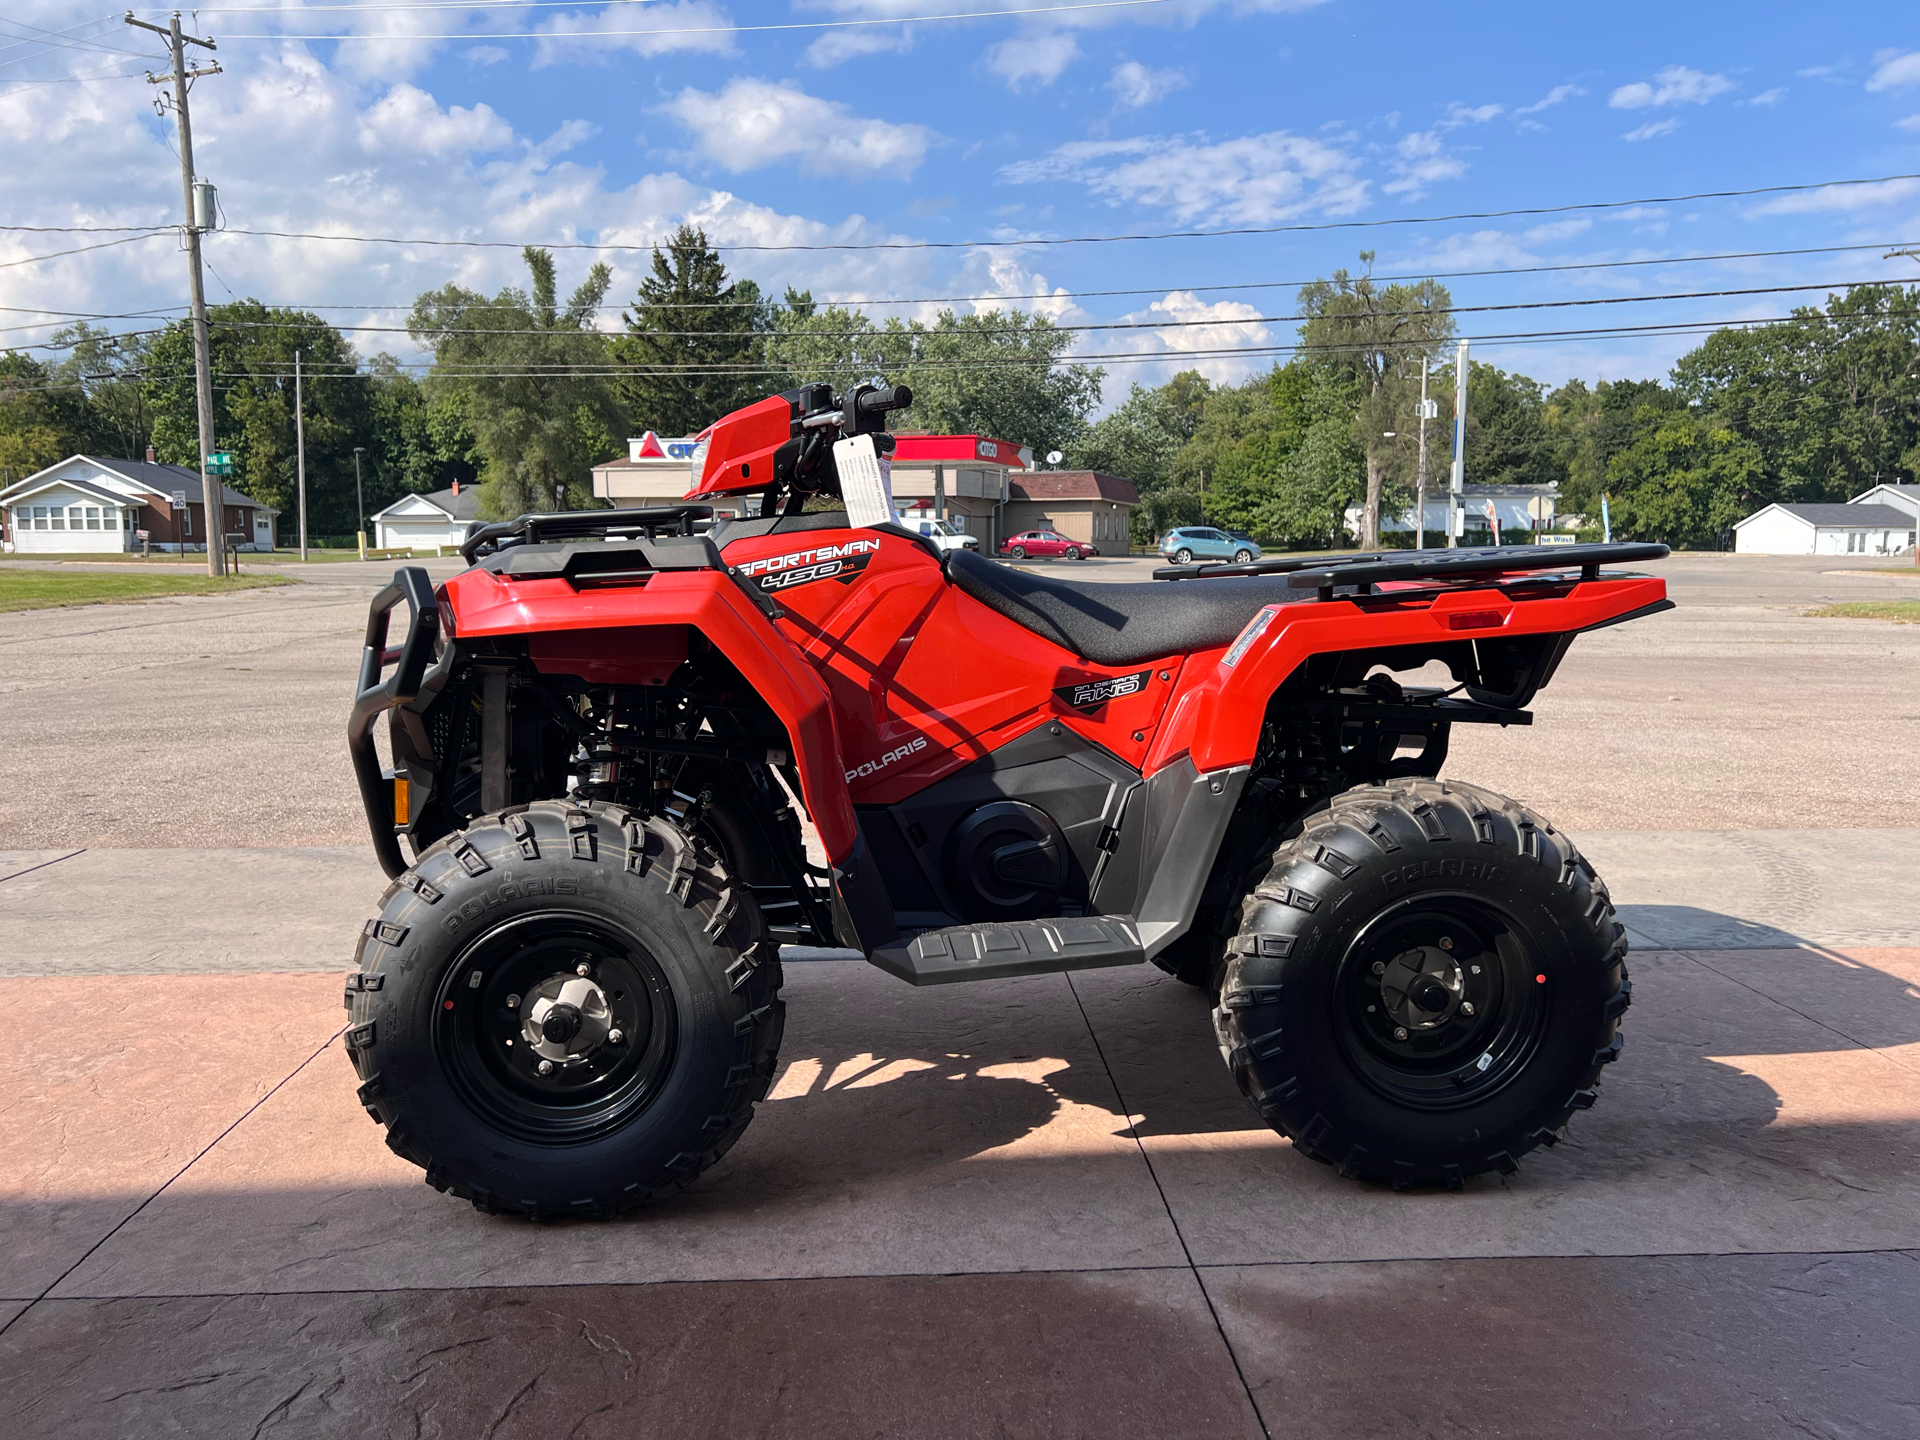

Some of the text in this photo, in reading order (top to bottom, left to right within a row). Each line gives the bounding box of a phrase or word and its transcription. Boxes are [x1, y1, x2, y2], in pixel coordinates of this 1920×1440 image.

[668, 443, 700, 459] CIT
[978, 441, 997, 458] CITGO
[867, 454, 877, 479] WARRANTY
[738, 538, 880, 576] SPORTSMAN
[761, 560, 843, 588] 450
[1074, 674, 1140, 692] ON DEMAND
[1074, 680, 1140, 705] AWD
[844, 736, 928, 784] POLARIS
[1381, 859, 1511, 891] POLARIS
[441, 877, 579, 936] POLARIS
